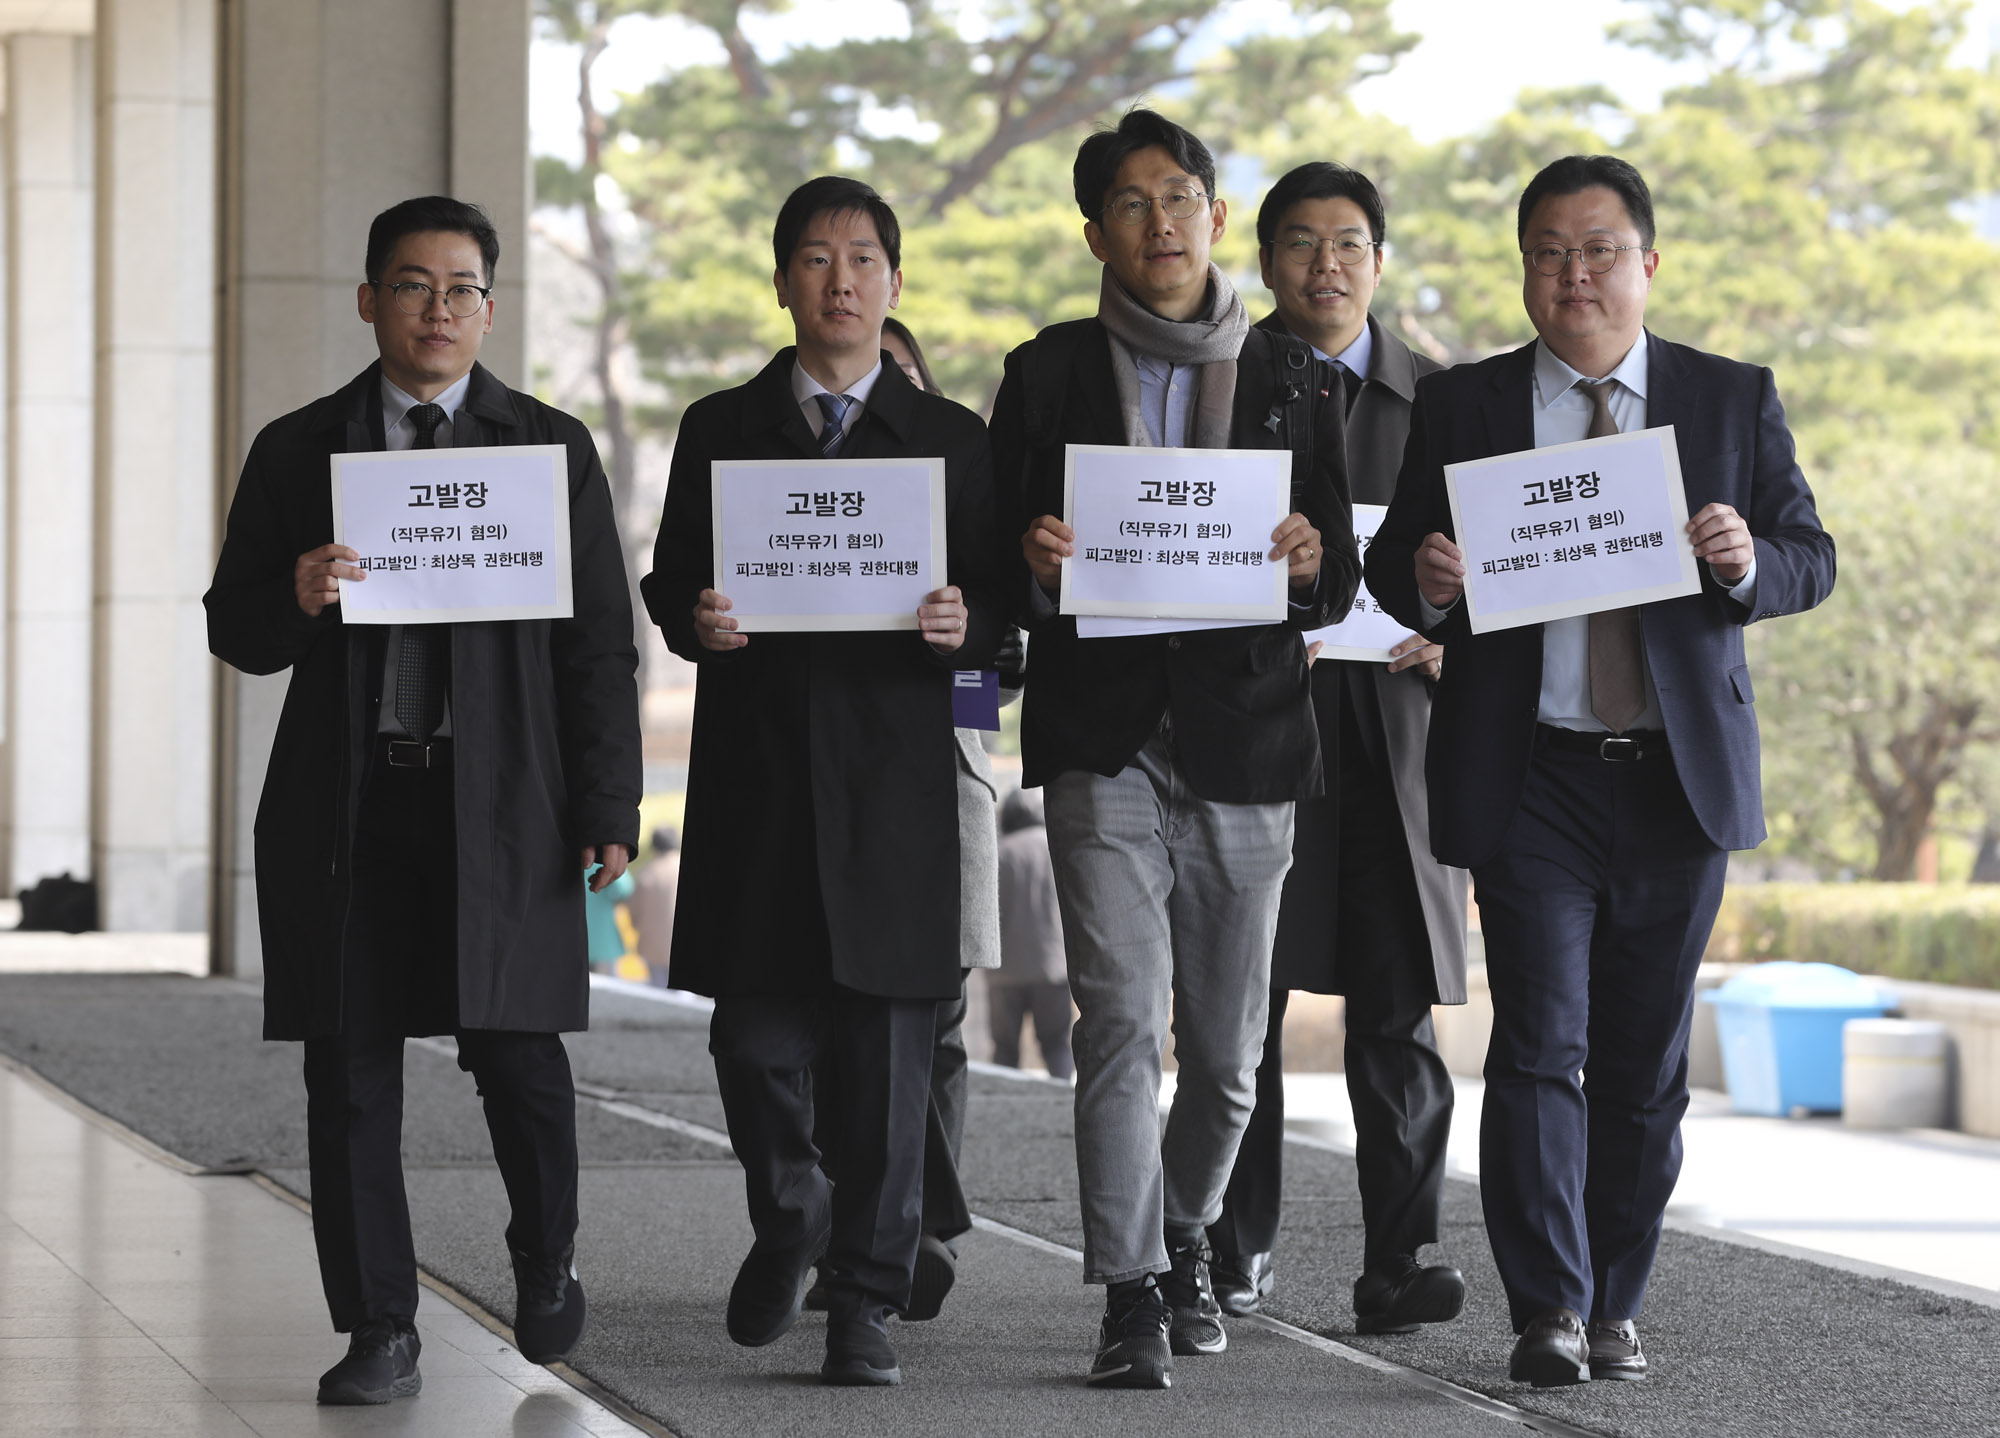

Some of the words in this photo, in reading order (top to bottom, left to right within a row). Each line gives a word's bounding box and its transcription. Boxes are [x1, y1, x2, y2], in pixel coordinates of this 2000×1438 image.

[408, 481, 489, 509] 고발장
[1137, 480, 1217, 507] 고발장
[1523, 471, 1601, 507] 고발장
[786, 491, 865, 517] 고발장
[391, 525, 461, 543] (직무유기
[470, 523, 508, 542] 혐의)
[1119, 520, 1188, 538] (직무유기
[1196, 523, 1232, 539] 혐의)
[1510, 517, 1580, 543] (직무유기
[1587, 509, 1625, 531] 혐의)
[768, 533, 838, 550] (직무유기
[846, 532, 884, 549] 혐의)
[1553, 543, 1598, 563] 최상목
[1604, 531, 1664, 555] 권한대행
[431, 553, 476, 570] 최상목
[483, 551, 543, 568] 권한대행
[807, 561, 851, 576] 최상목
[859, 560, 919, 576] 권한대행
[1156, 550, 1200, 566] 최상목
[1207, 551, 1263, 566] 권한대행
